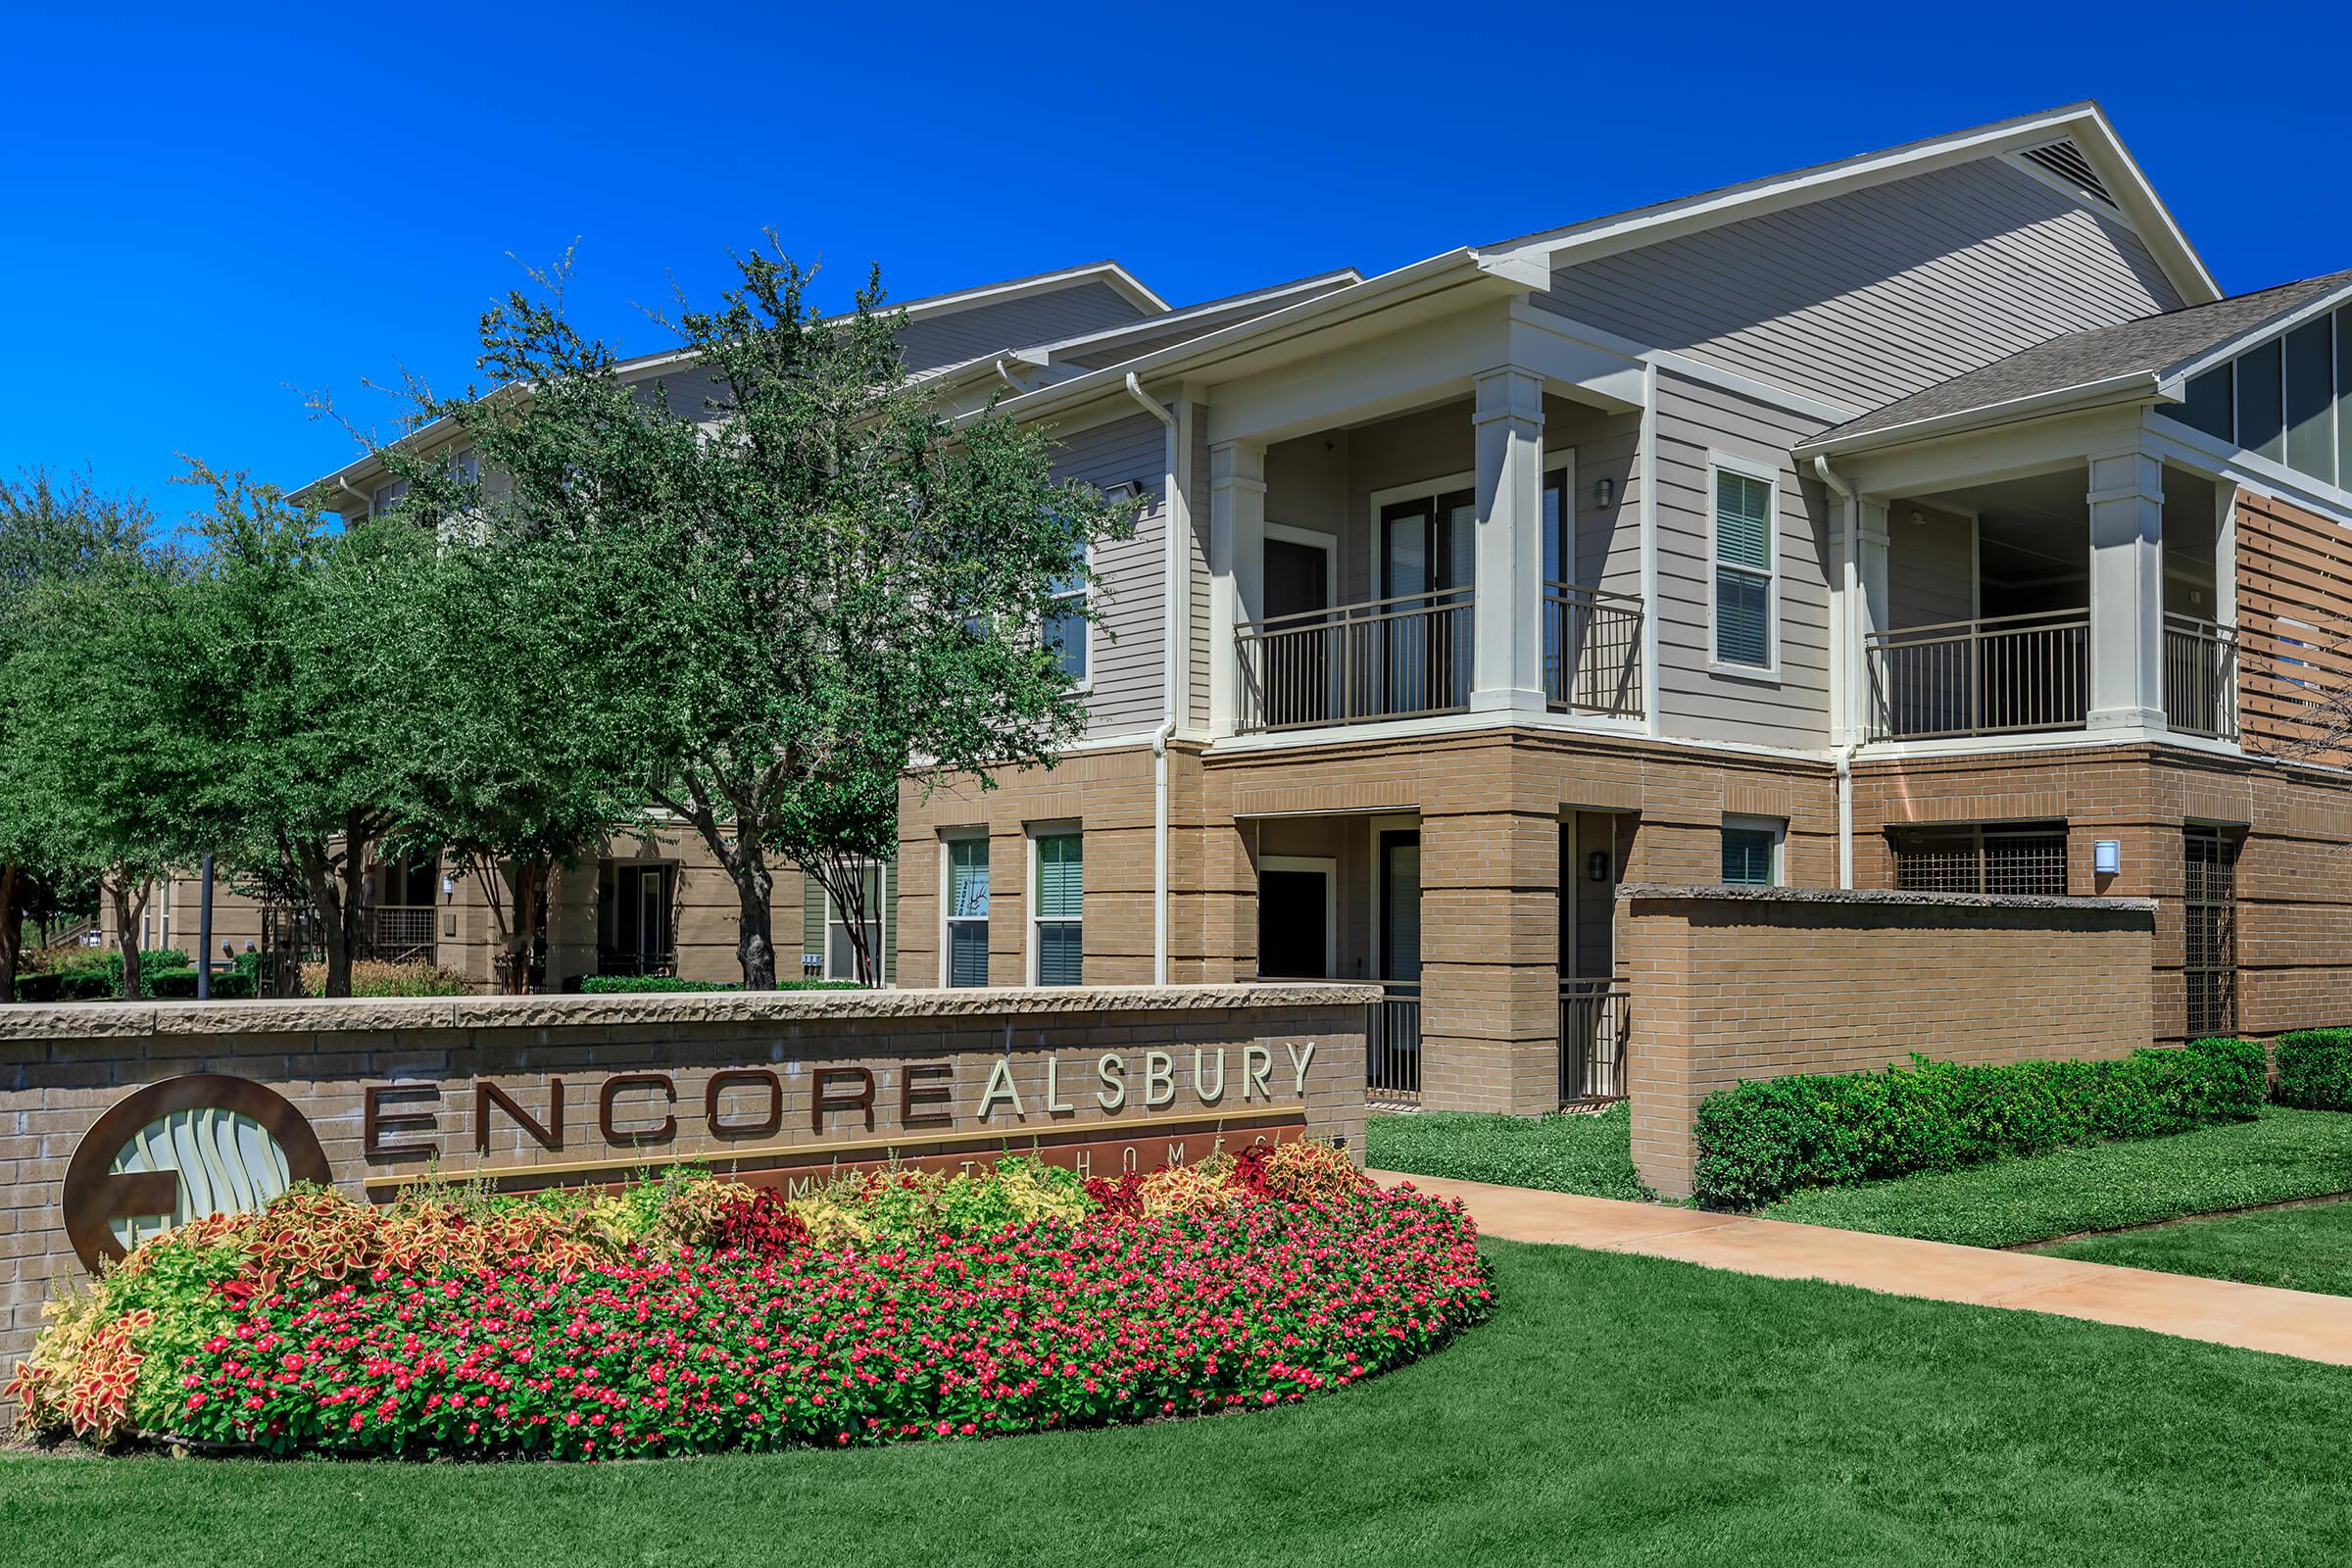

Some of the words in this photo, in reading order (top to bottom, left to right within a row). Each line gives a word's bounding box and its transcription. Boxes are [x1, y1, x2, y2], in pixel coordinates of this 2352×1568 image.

[958, 882, 968, 916] 2020
[364, 1063, 954, 1154] ENCORE
[977, 1042, 1315, 1117] ALSBURY
